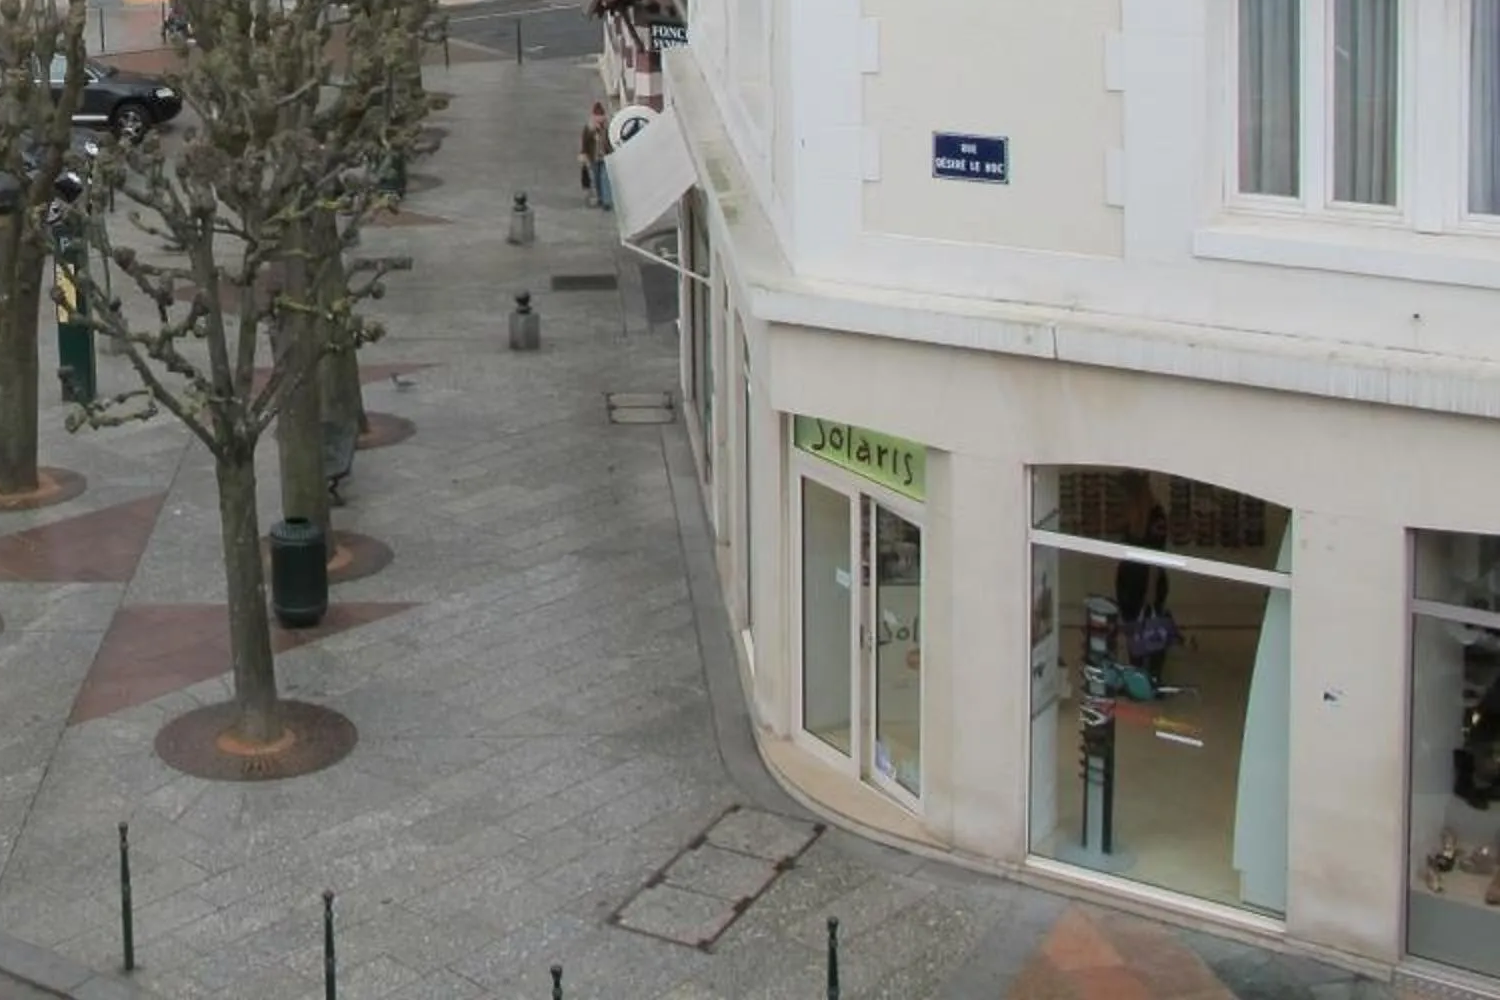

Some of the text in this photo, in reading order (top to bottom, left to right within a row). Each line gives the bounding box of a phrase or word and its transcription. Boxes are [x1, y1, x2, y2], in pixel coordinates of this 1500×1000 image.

[652, 25, 690, 39] FONC
[962, 143, 977, 154] RUE
[970, 161, 981, 172] LE
